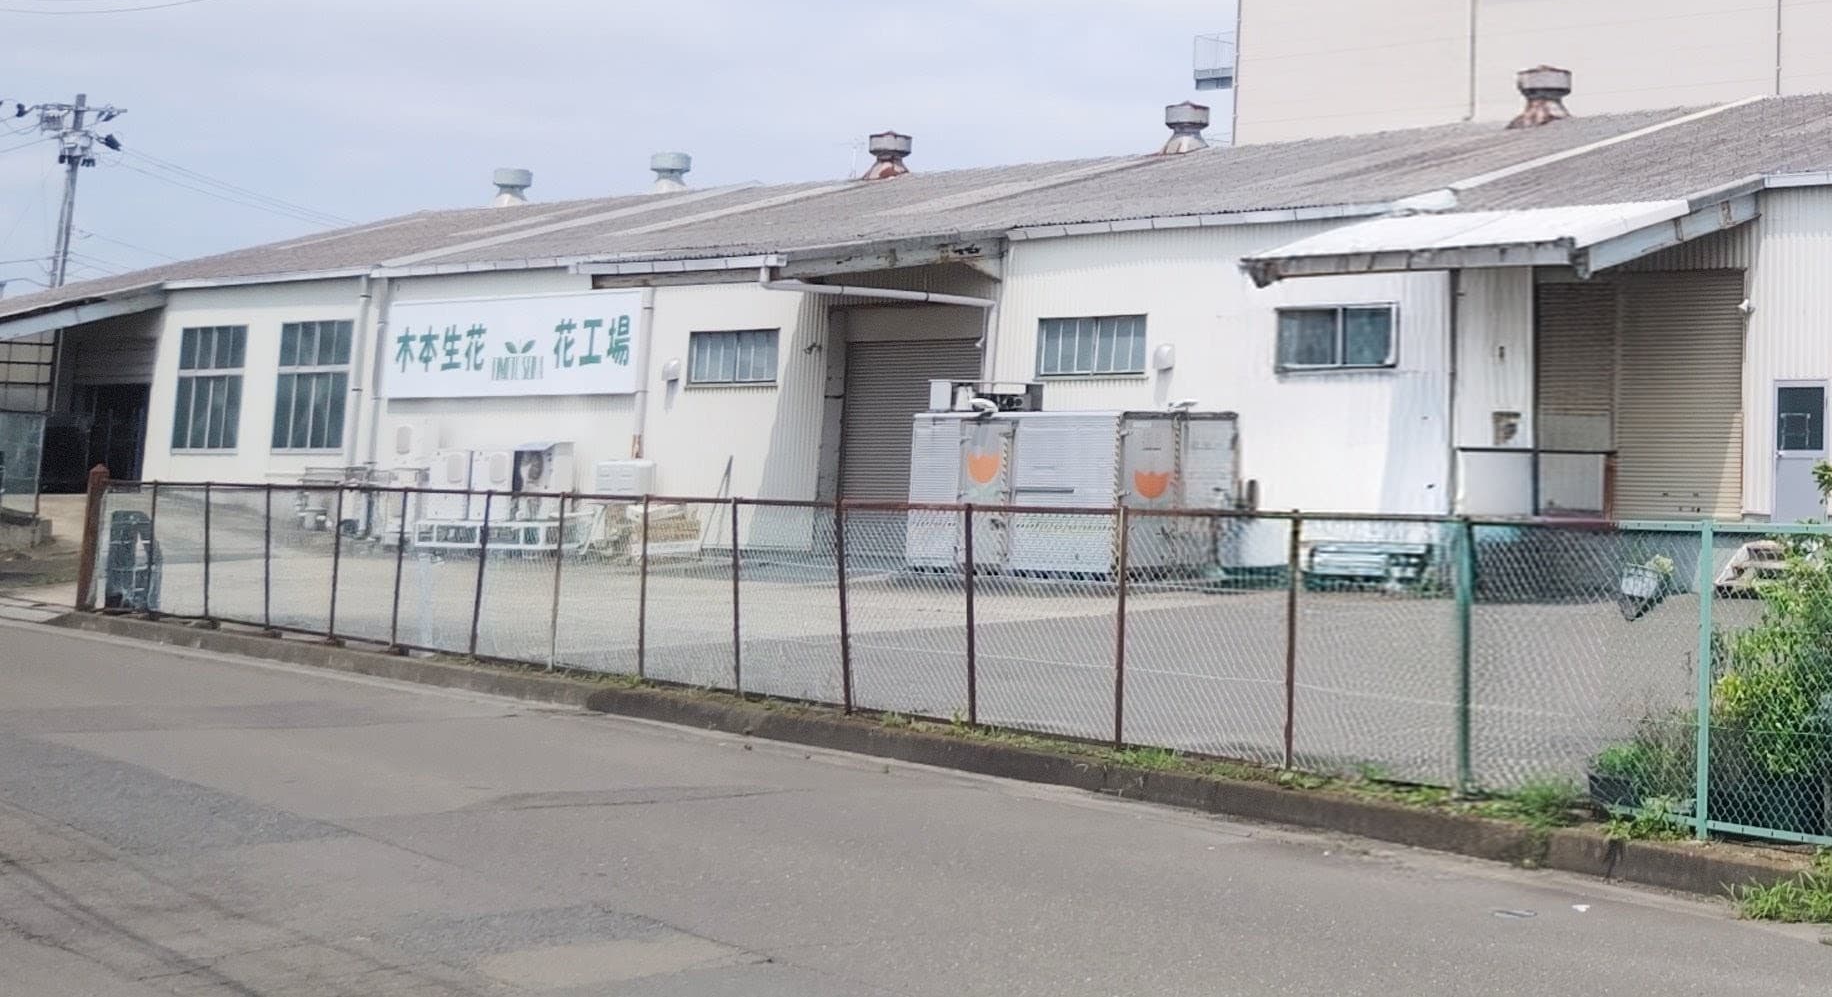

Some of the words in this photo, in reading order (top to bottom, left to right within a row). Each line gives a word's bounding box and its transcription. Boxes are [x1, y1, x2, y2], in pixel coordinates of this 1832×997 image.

[395, 323, 487, 373] 木本生花
[553, 315, 631, 369] 花工場
